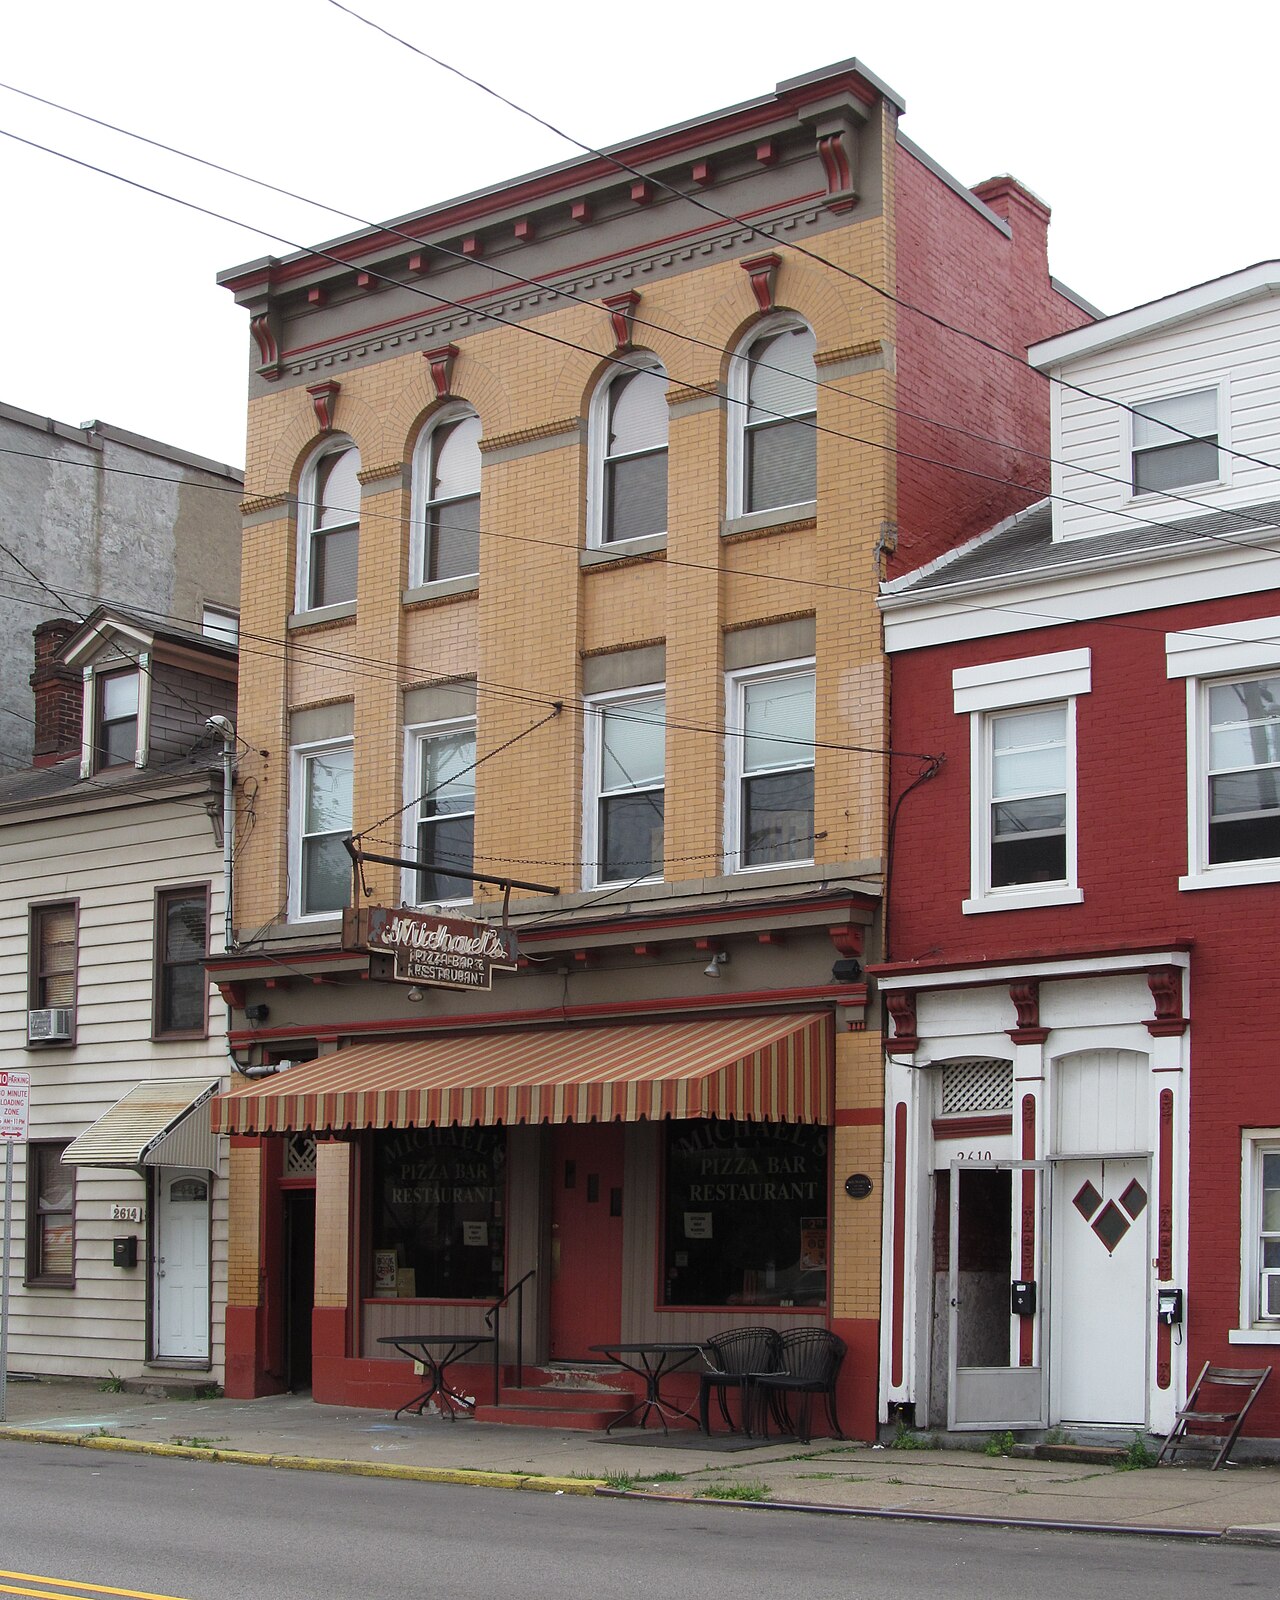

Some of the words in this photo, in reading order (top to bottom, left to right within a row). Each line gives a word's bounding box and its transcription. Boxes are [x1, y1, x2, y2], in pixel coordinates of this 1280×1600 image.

[382, 917, 508, 959] Michael's
[408, 963, 485, 985] RESTAURANT
[0, 1073, 8, 1085] O
[8, 1075, 29, 1085] PARKING
[8, 1090, 28, 1098] MINUTE
[4, 1108, 19, 1116] ZONE
[678, 1121, 827, 1159] MICHAEL'S
[401, 1164, 449, 1180] PIZZA
[455, 1163, 488, 1179] BAR
[700, 1157, 759, 1176] PIZZA
[767, 1155, 807, 1174] BAR
[392, 1187, 497, 1204] RESTAURANT
[689, 1182, 818, 1201] RESTAURANT
[113, 1207, 137, 1219] 2614
